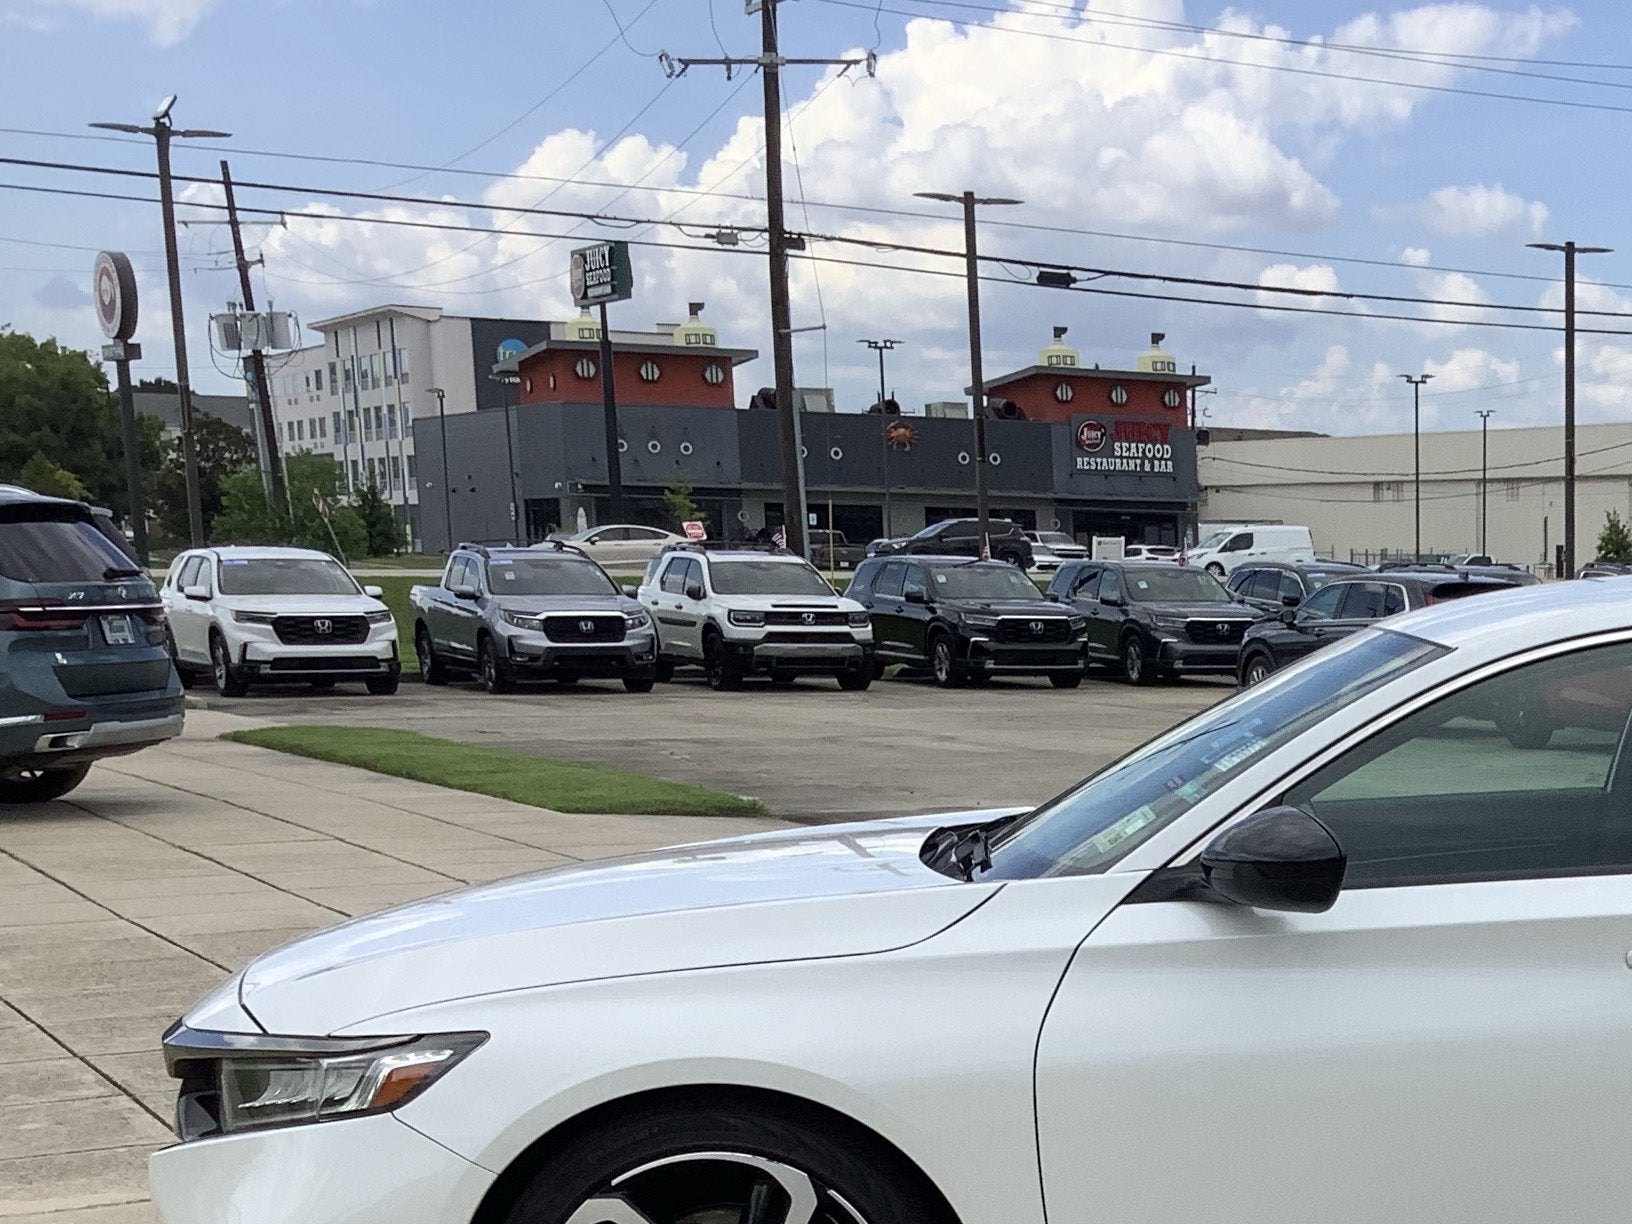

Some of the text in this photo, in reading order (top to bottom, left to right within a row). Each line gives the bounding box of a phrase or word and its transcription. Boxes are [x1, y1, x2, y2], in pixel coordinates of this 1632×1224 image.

[585, 245, 610, 271] JUICY
[1113, 441, 1172, 459] SEAFOOD
[1076, 456, 1174, 473] RESTAURANT & BAR
